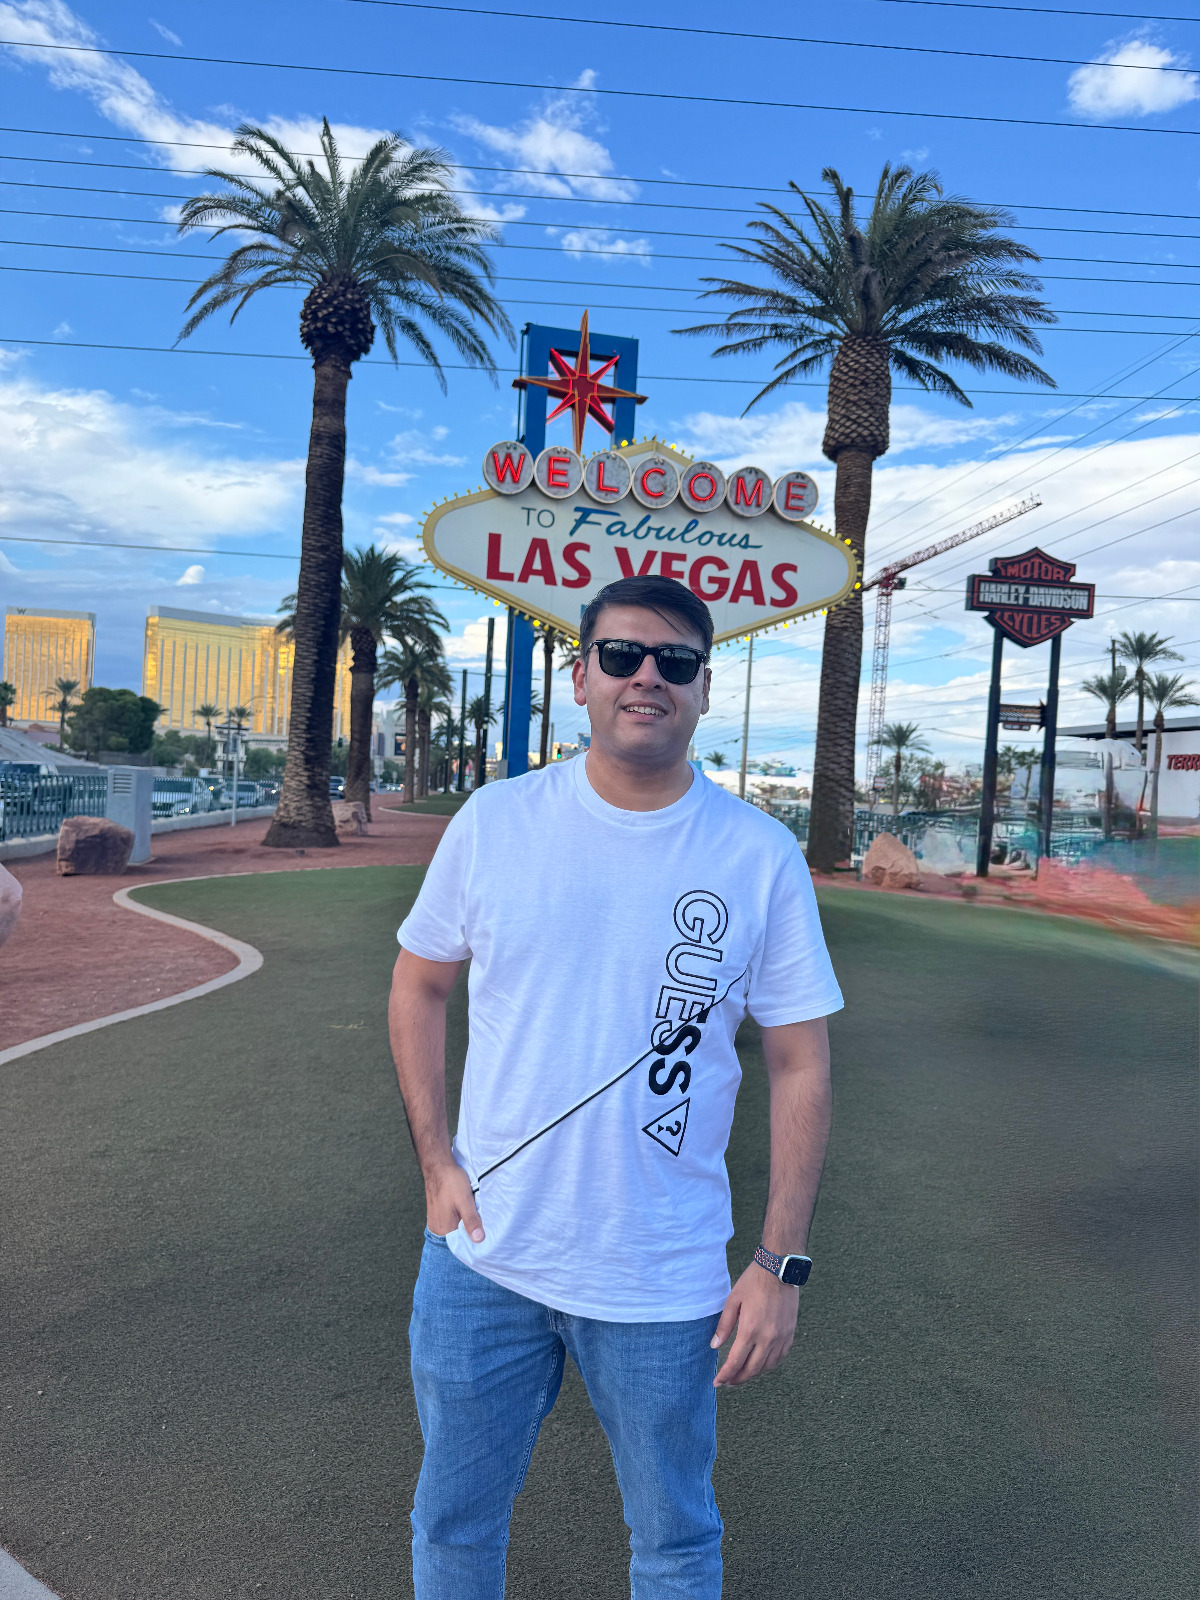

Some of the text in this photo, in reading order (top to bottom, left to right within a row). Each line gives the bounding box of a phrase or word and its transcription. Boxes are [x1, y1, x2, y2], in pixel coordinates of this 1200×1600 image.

[491, 451, 807, 512] WELCOME
[521, 506, 764, 549] TO Fabulous
[485, 532, 799, 608] LAS VEGAS
[1006, 556, 1065, 582] MOTOR
[979, 581, 1089, 611] HARLEY-DAVIDSON
[1003, 611, 1061, 639] CYCLES
[648, 889, 729, 1096] GUESS
